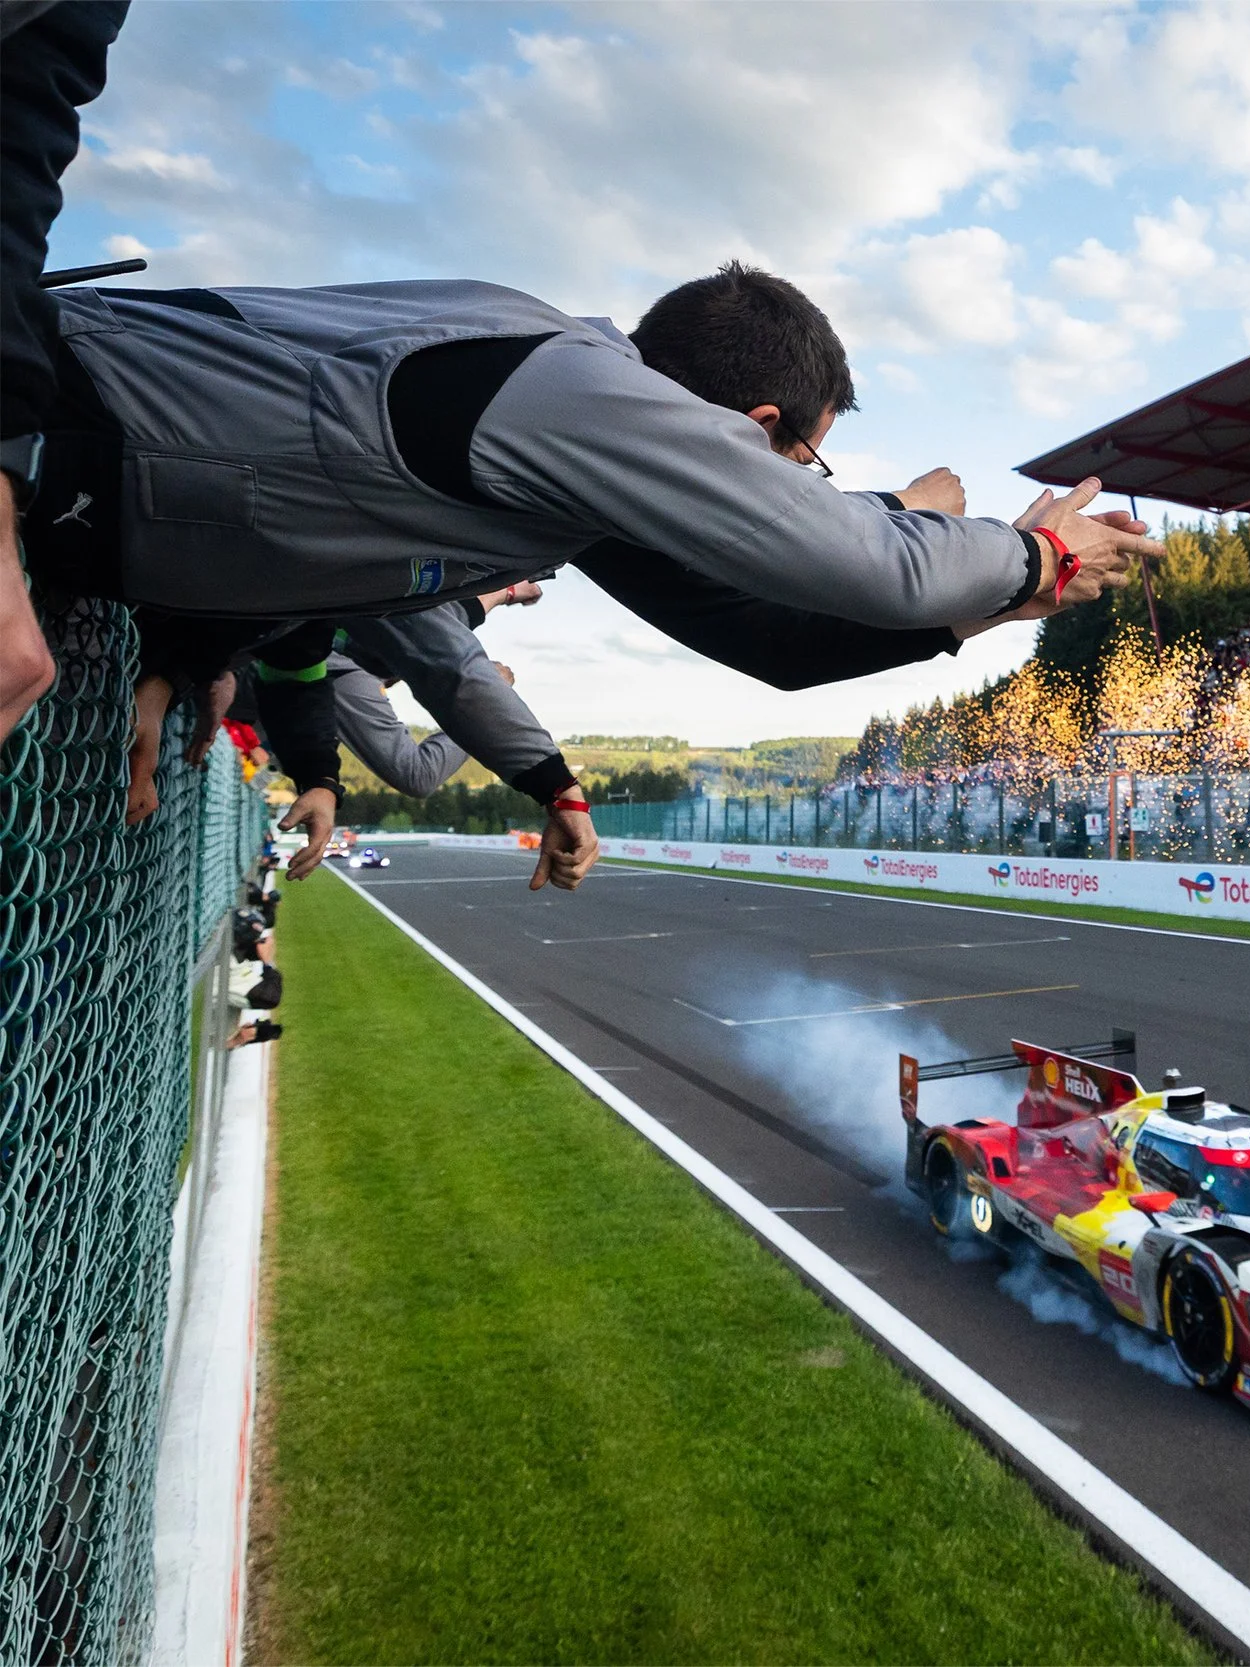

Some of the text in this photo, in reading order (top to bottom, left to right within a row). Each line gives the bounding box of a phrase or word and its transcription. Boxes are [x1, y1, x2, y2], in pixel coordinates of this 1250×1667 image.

[1013, 866, 1099, 896] TotalEnergies
[1065, 1075, 1103, 1103] HELIX
[1101, 1264, 1138, 1297] 20
